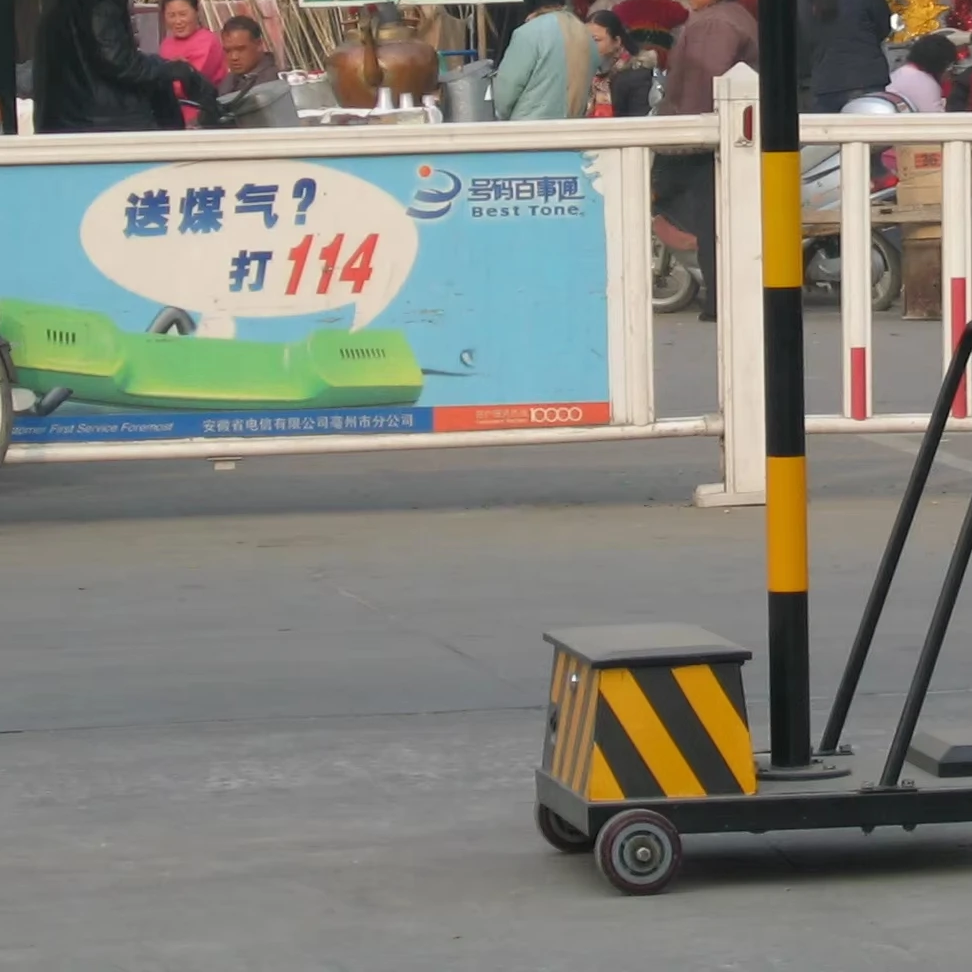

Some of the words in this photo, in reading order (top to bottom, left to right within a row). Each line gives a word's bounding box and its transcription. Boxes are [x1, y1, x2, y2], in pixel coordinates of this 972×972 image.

[467, 176, 585, 203] 号码百事通
[122, 178, 317, 239] 送煤气？
[471, 206, 520, 218] Best
[530, 406, 583, 423] 10000
